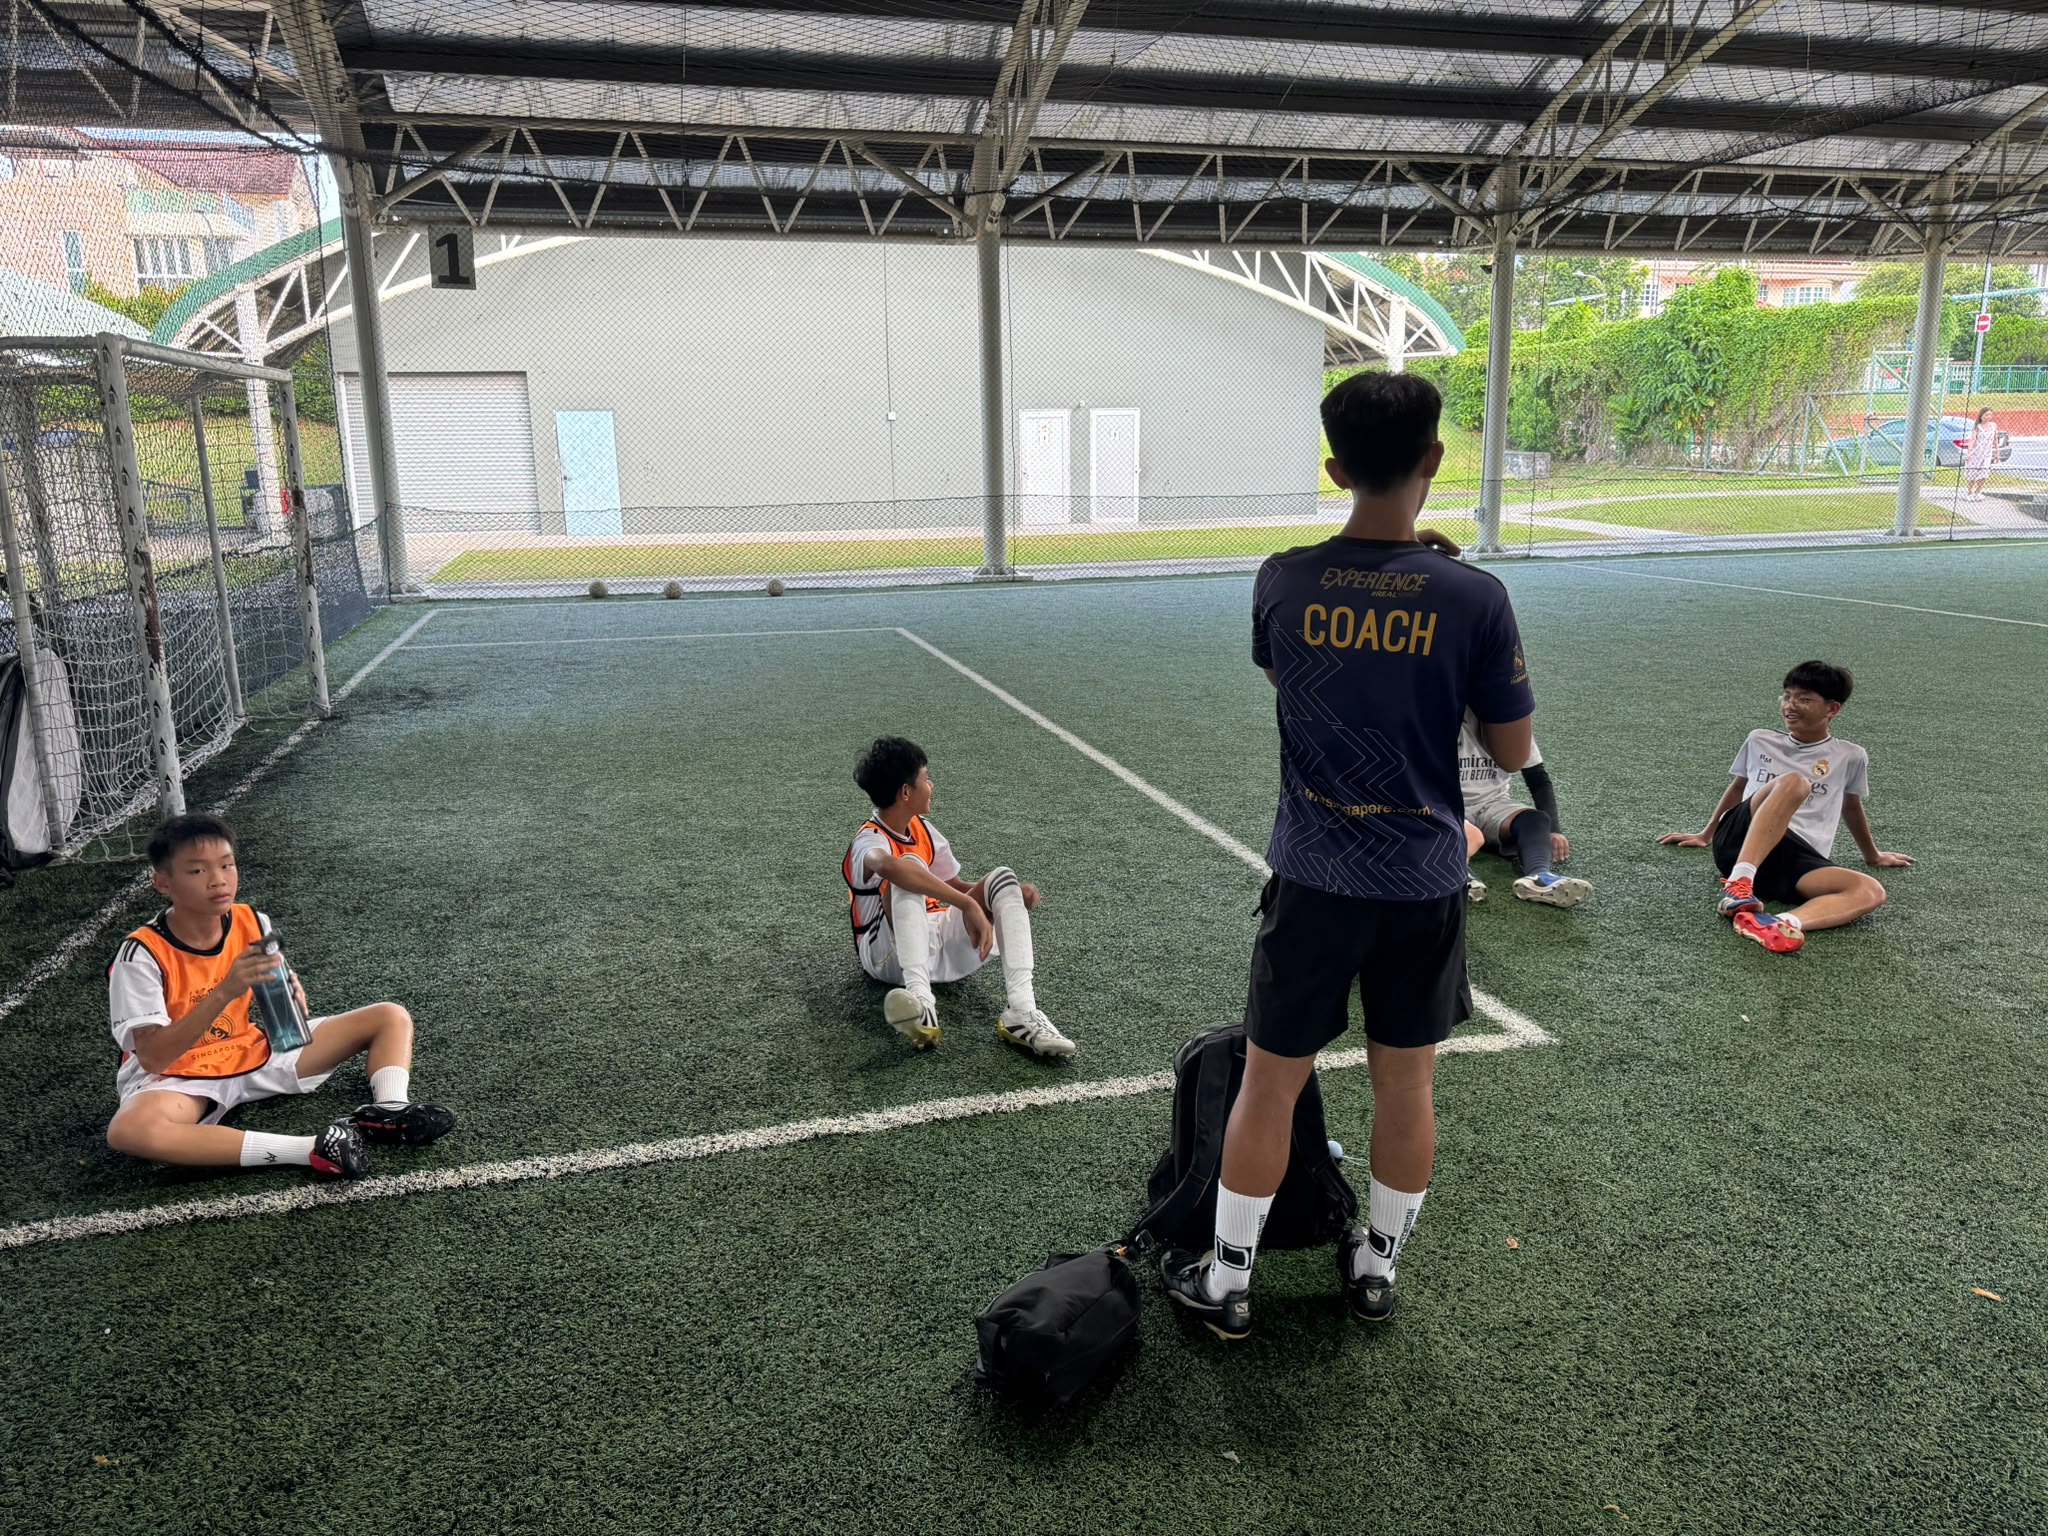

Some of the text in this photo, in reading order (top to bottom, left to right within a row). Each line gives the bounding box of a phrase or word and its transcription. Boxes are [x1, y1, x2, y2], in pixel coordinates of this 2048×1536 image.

[436, 233, 470, 284] 1
[1320, 568, 1430, 591] EXPERIENCE
[1304, 604, 1437, 656] COACH
[1470, 768, 1497, 781] BETTER
